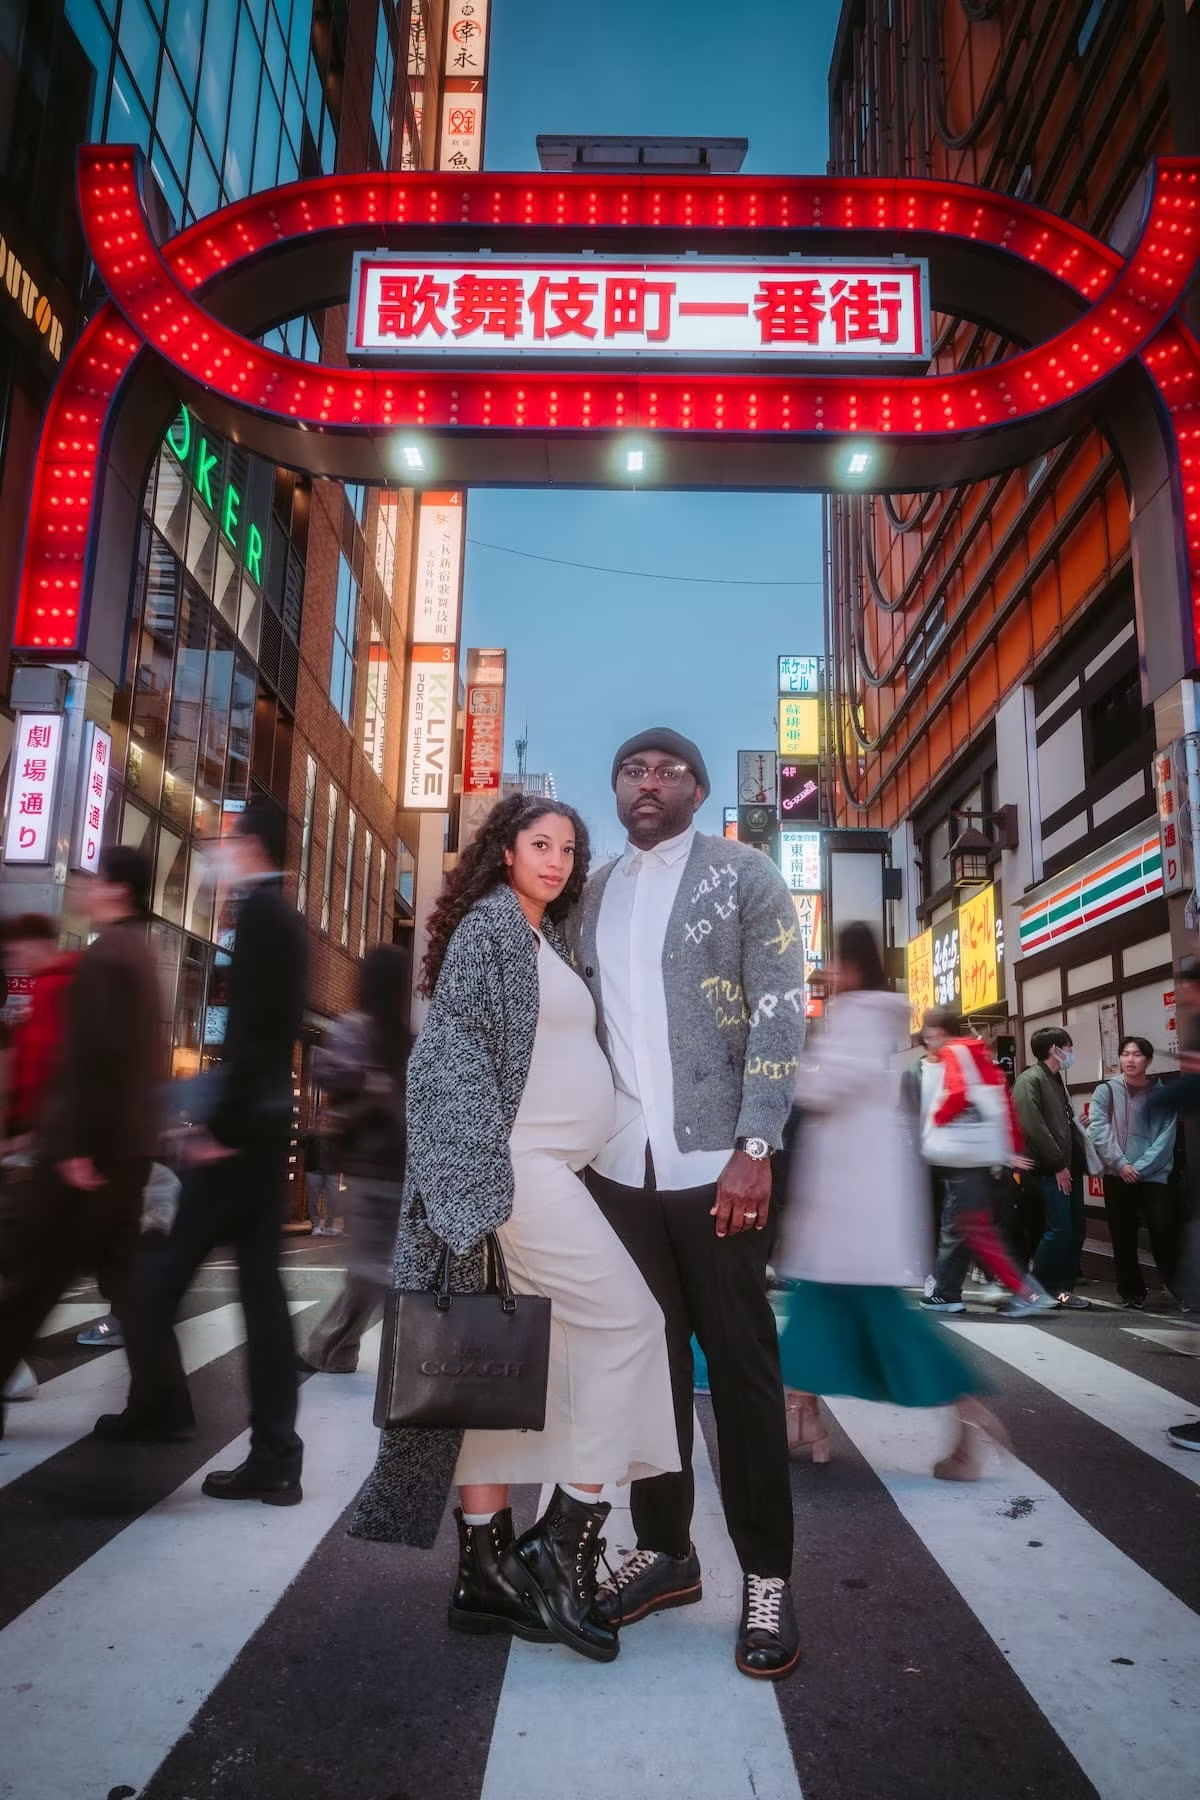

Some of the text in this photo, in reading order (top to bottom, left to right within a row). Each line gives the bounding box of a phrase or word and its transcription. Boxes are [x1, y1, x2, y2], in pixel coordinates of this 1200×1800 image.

[470, 80, 479, 92] 7
[377, 274, 901, 345] 歌舞伎町一番街
[449, 491, 458, 504] 4
[441, 647, 451, 661] 3
[781, 659, 815, 675] ポケット
[789, 676, 809, 691] ビル
[411, 673, 425, 796] POKER SHINJUKU
[423, 673, 448, 796] KKLIVE
[469, 717, 496, 789] 安楽亭
[19, 725, 52, 848] 劇場通り
[782, 766, 797, 777] 4F
[87, 740, 107, 860] 劇場通り
[790, 843, 804, 888] 東南荘
[420, 1360, 525, 1377] COACH
